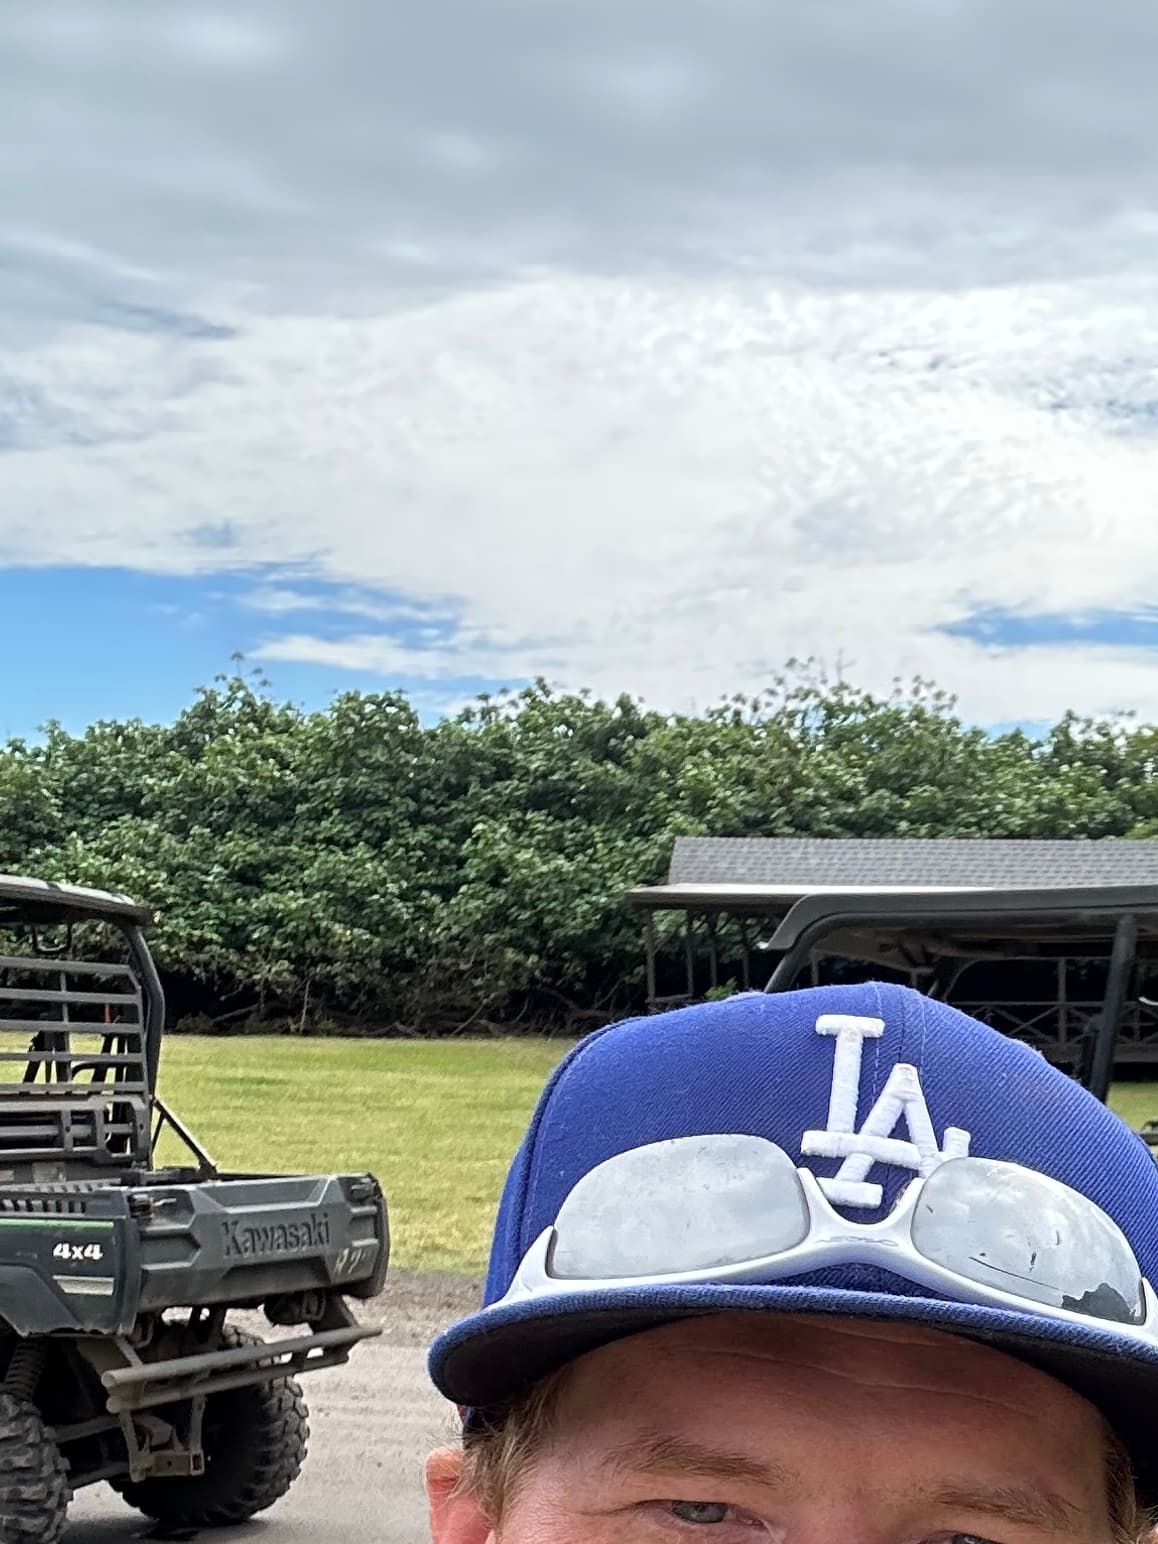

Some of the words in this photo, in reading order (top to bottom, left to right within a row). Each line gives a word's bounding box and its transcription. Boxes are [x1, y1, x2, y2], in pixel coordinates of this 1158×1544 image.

[801, 1014, 971, 1208] LA
[52, 1242, 103, 1260] 4x4
[222, 1212, 330, 1255] Kawasaki
